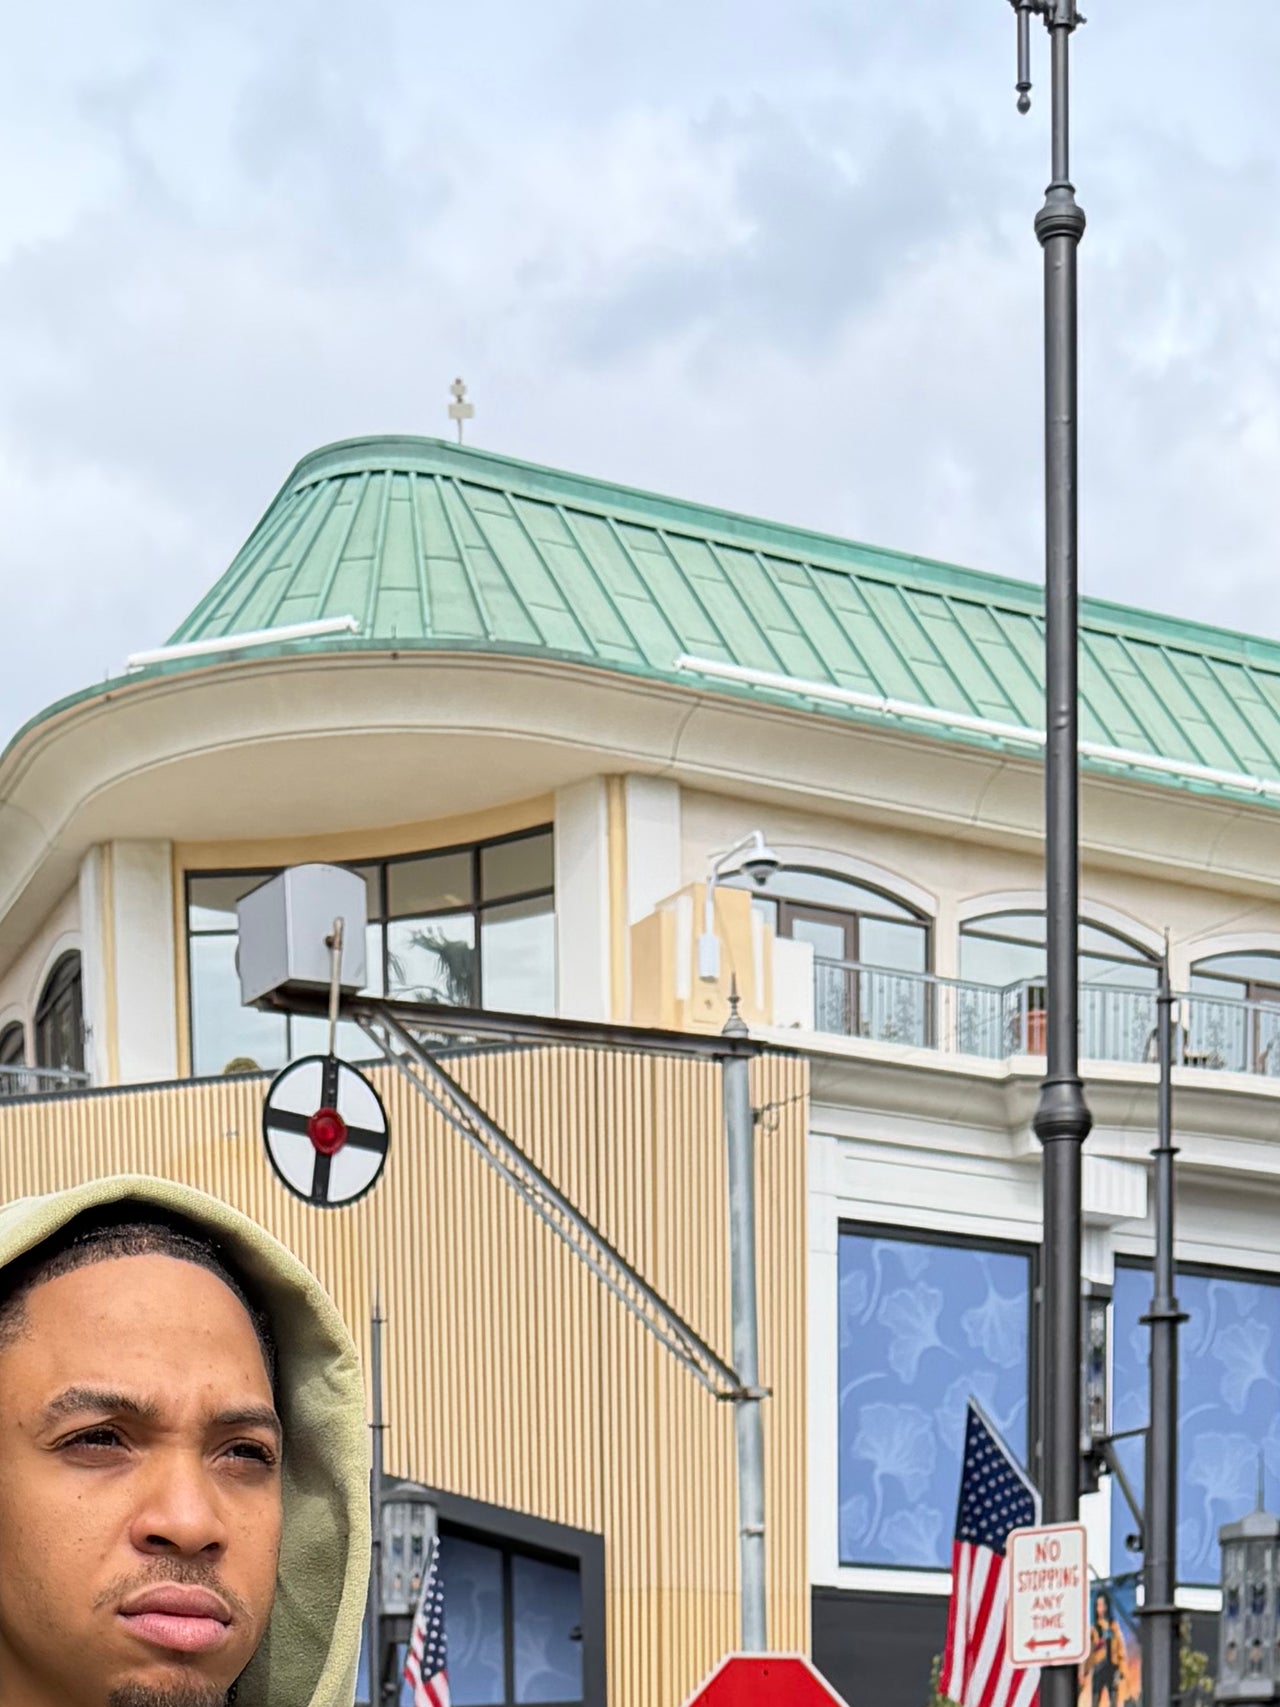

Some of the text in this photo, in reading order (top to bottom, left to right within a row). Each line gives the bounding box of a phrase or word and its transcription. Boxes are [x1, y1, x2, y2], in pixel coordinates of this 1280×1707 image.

[1034, 1539, 1061, 1563] NO
[1018, 1567, 1079, 1592] STOPPING
[1032, 1592, 1064, 1611] ANY
[1032, 1612, 1064, 1630] TIME
